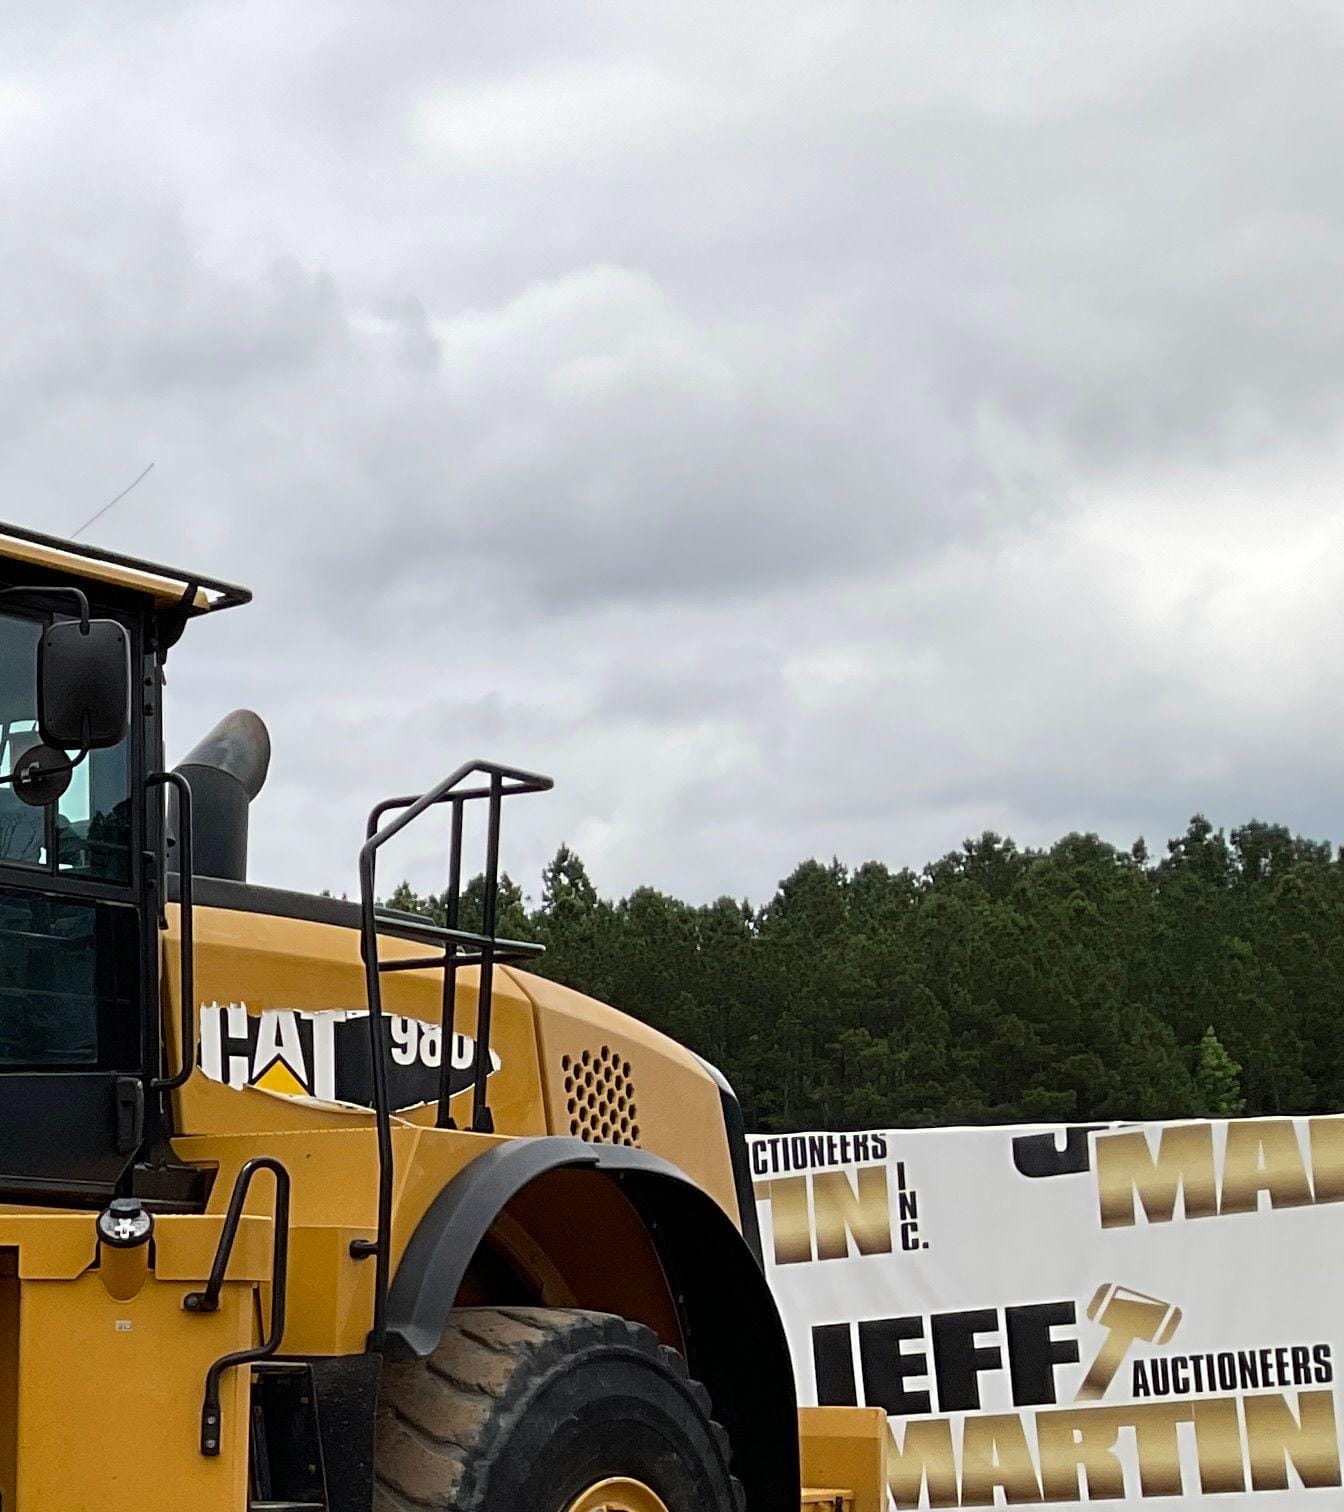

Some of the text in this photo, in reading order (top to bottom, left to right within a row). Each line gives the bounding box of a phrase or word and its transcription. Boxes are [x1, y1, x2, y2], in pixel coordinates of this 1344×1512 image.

[200, 1001, 346, 1102] CAT
[1132, 1344, 1333, 1398] AUCTIONEERS
[887, 1390, 1342, 1511] MARTIN
